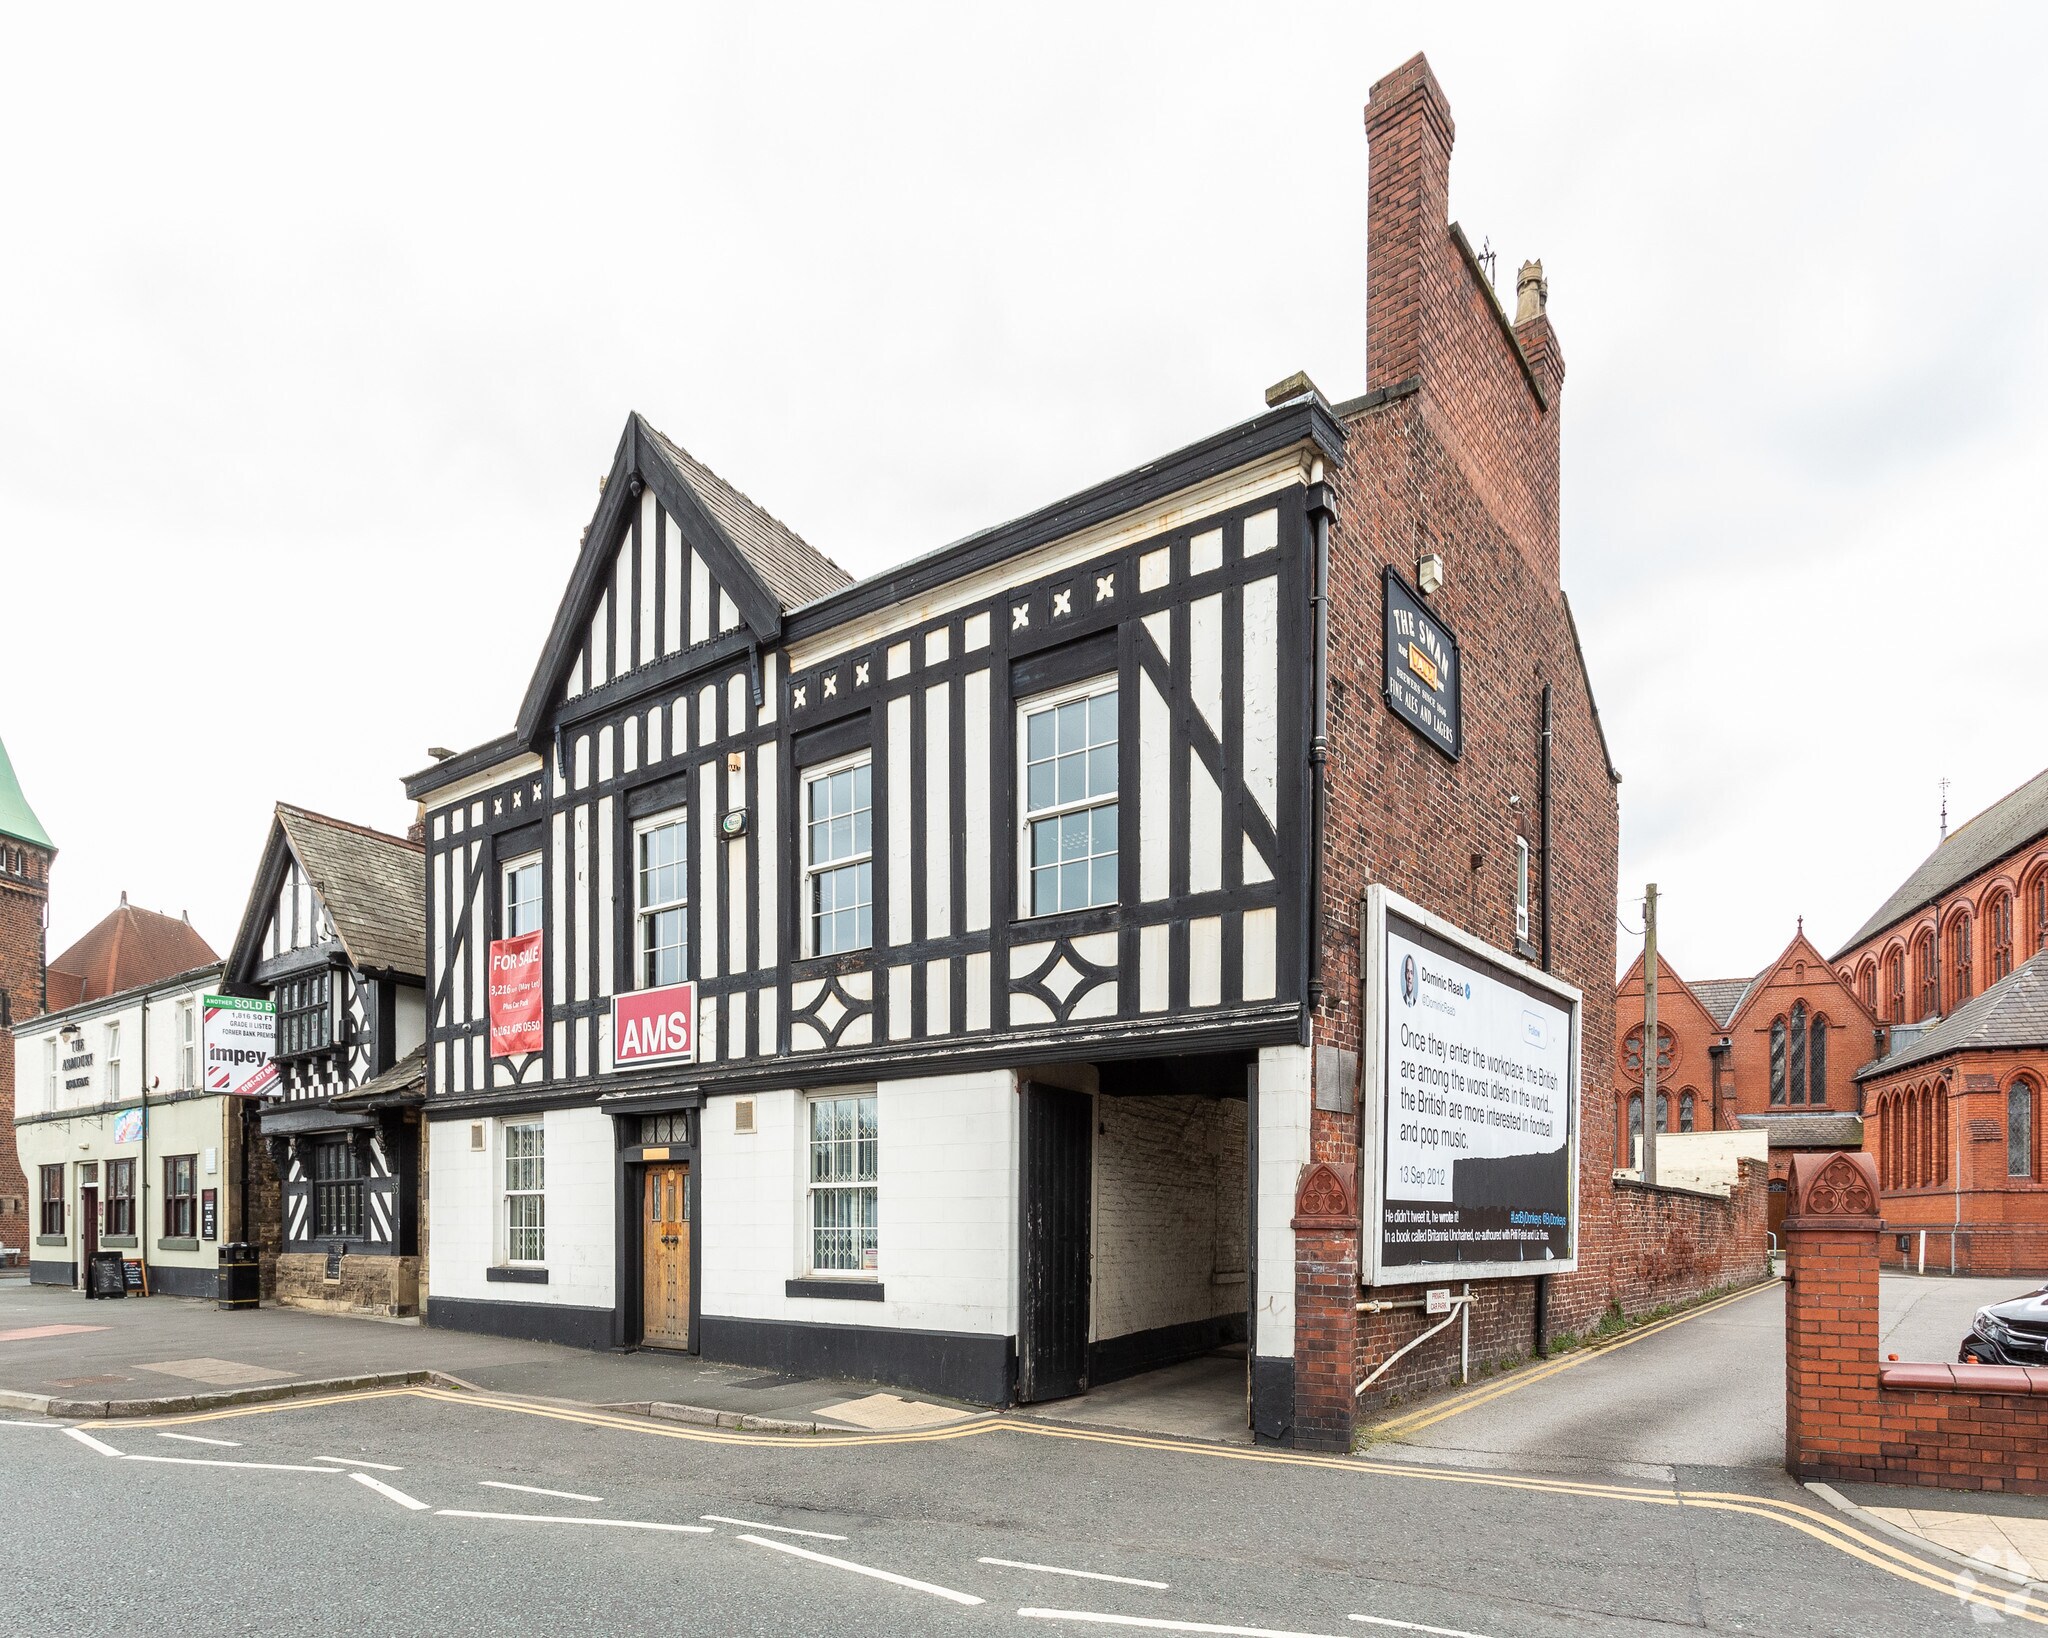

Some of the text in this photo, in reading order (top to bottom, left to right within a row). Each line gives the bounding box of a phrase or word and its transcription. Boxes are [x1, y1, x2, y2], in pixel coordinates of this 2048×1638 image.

[1393, 609, 1448, 681] THE SWAN
[1396, 666, 1420, 694] BREWERS
[1422, 689, 1436, 708] SINCE
[1390, 676, 1453, 743] FINE ALES AND LAGERS
[494, 946, 539, 970] FOR SALE
[1422, 967, 1463, 996] Dominic Raab
[234, 999, 262, 1010] SOLD
[520, 999, 529, 1007] Park
[1422, 994, 1456, 1016] @DominicRaab
[511, 1023, 522, 1033] 475
[523, 1020, 540, 1032] 0550
[621, 1011, 687, 1056] AMS
[1528, 1024, 1540, 1038] Follow
[210, 1043, 266, 1067] impey
[1401, 1023, 1558, 1091] Once they enter the workplace, the British
[1401, 1060, 1554, 1114] are among the worst idlers in the world...
[1401, 1086, 1553, 1137] the British are more interested in football
[1400, 1120, 1468, 1150] and pop music.
[1400, 1166, 1445, 1188] 13 Sep 2012
[1385, 1209, 1393, 1222] He
[1394, 1210, 1410, 1222] didn't
[1411, 1210, 1425, 1222] tweet
[1432, 1210, 1438, 1222] he
[1439, 1211, 1453, 1222] wrote
[1510, 1211, 1541, 1227] #LedByDonkeys
[1385, 1229, 1390, 1242] In
[1391, 1232, 1395, 1242] a
[1396, 1229, 1410, 1242] book
[1411, 1229, 1426, 1242] called
[1428, 1229, 1449, 1242] Britannia
[1449, 1229, 1474, 1242] Unchained,
[1502, 1229, 1510, 1240] with
